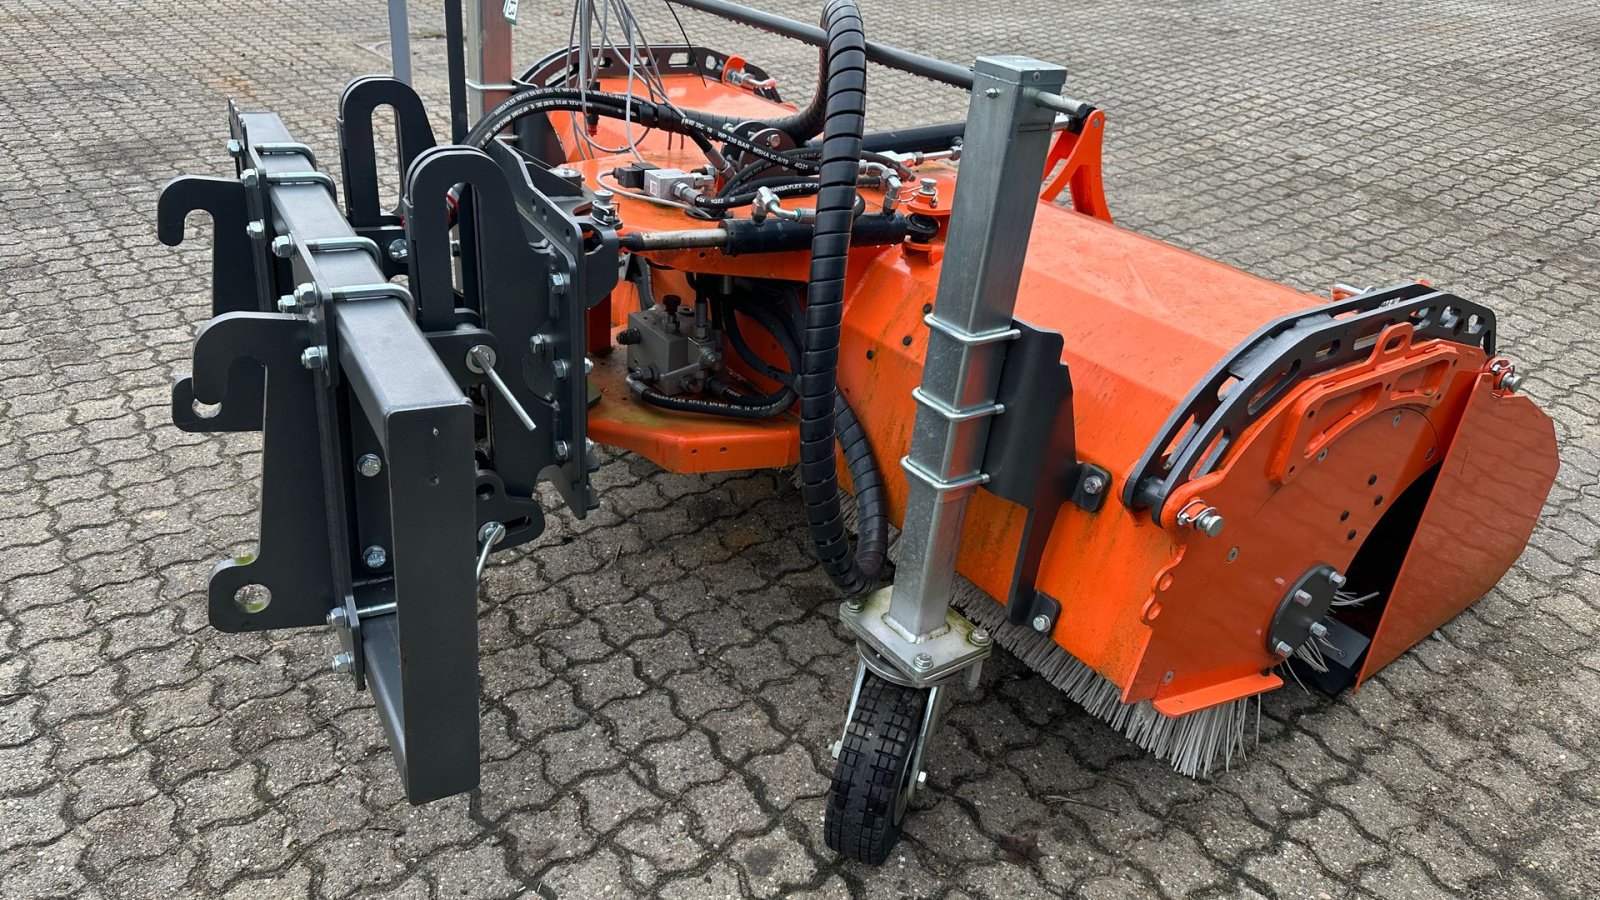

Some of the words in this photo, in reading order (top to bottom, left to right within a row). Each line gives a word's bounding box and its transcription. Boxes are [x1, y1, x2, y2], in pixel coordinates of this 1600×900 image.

[717, 131, 728, 139] WP
[727, 135, 738, 144] 330
[737, 140, 751, 150] BAR
[752, 147, 770, 158] MSHA
